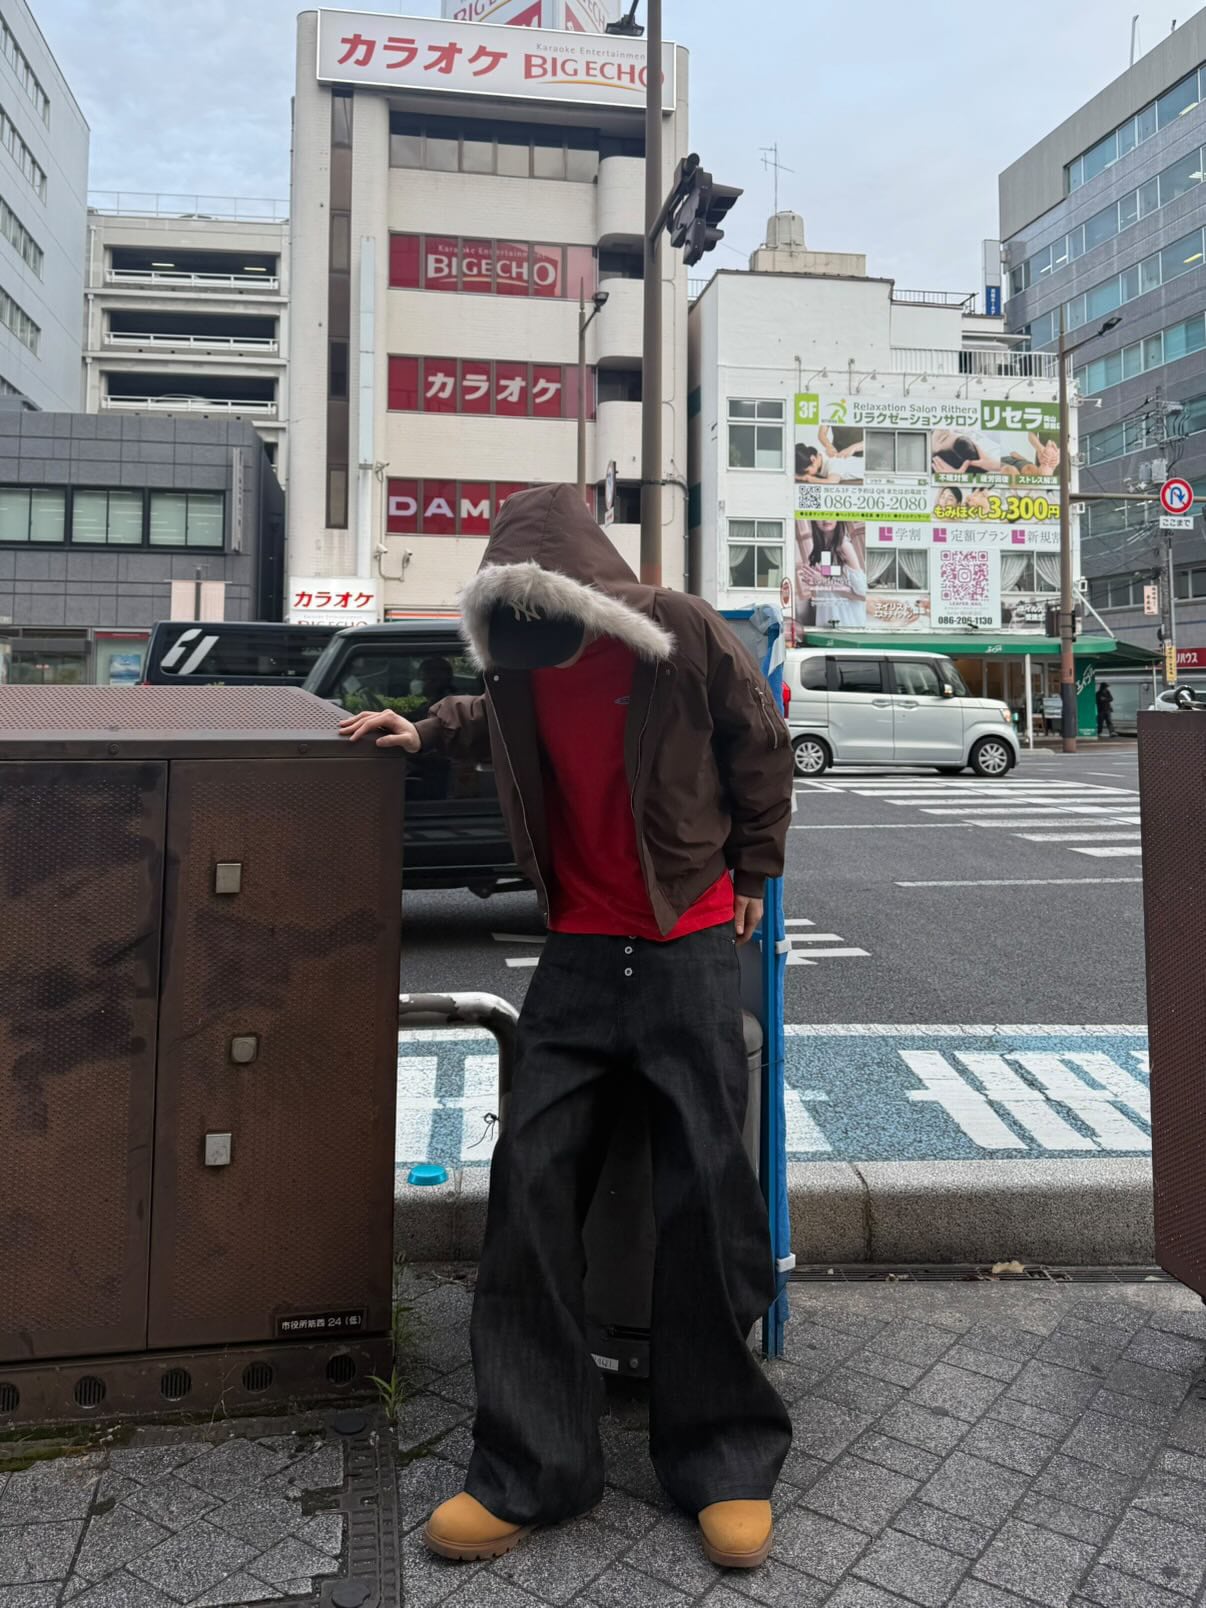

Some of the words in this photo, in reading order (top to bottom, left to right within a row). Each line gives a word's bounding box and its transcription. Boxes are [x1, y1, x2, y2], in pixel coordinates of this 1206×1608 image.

[337, 33, 508, 76] カラオケ
[536, 42, 576, 54] Karaoke
[580, 46, 646, 60] Entertainmen
[523, 54, 579, 80] BIG
[425, 372, 561, 403] カラオケ
[799, 401, 818, 419] 3F
[853, 402, 907, 412] Relaxation
[910, 404, 938, 414] Salon
[940, 405, 978, 414] Rithera
[853, 411, 979, 427] リラクゼーションサロン
[983, 405, 1043, 430] リセラ
[824, 494, 928, 511] 086-206-2080
[1162, 518, 1191, 527] ここまで
[896, 527, 921, 542] 学割
[950, 528, 1009, 543] 定額プラン
[293, 591, 375, 609] カラオケ
[328, 1316, 342, 1327] 24
